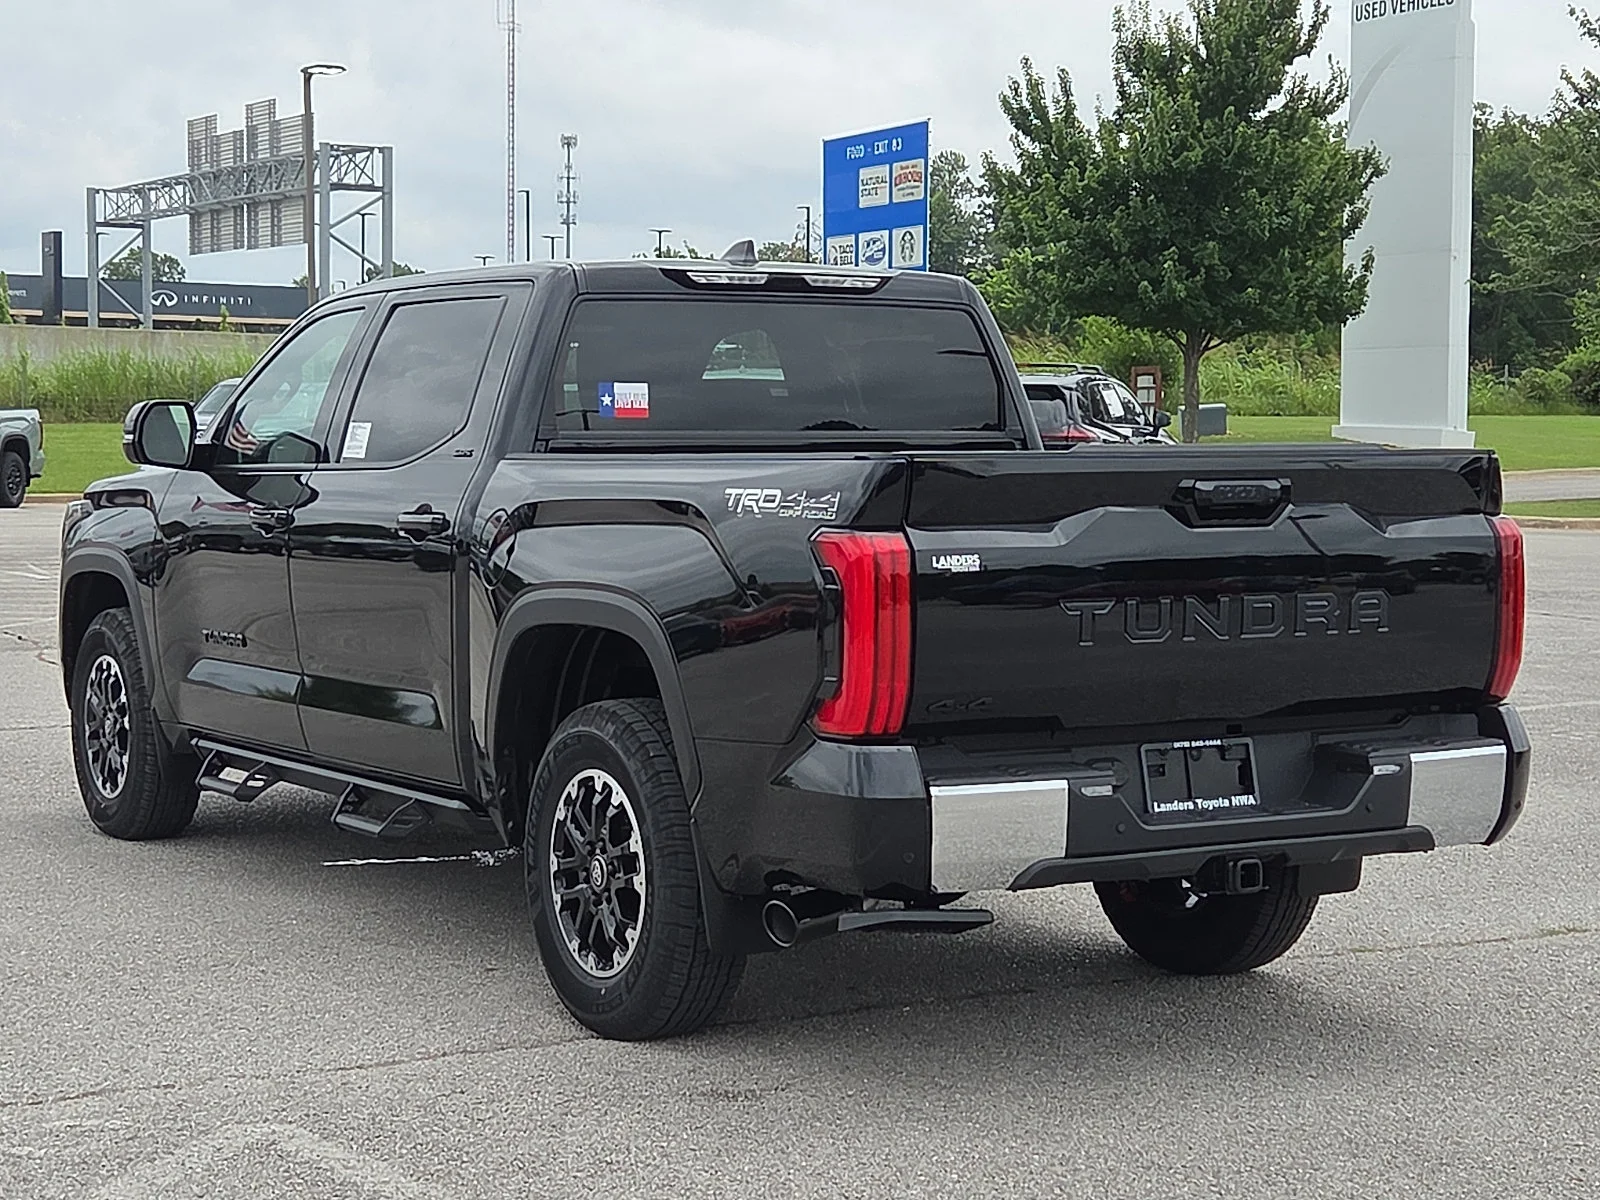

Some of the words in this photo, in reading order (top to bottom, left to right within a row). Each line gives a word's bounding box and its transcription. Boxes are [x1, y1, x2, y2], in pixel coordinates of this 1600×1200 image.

[1355, 0, 1387, 22] USED
[1390, 0, 1455, 15] VEHIC
[846, 144, 865, 160] FOOD
[874, 139, 889, 155] EXIT
[860, 175, 888, 187] NATURAL
[860, 187, 879, 198] STATE
[838, 243, 854, 254] TACO
[839, 255, 854, 266] BELL
[184, 294, 252, 306] INFINITI
[724, 487, 782, 518] TRD
[801, 509, 837, 520] ROAD
[931, 553, 981, 569] LANDERS
[1060, 588, 1392, 647] TUNDRA
[1153, 800, 1194, 813] Landers
[1195, 797, 1230, 811] Toyota
[1231, 794, 1257, 807] NWA
